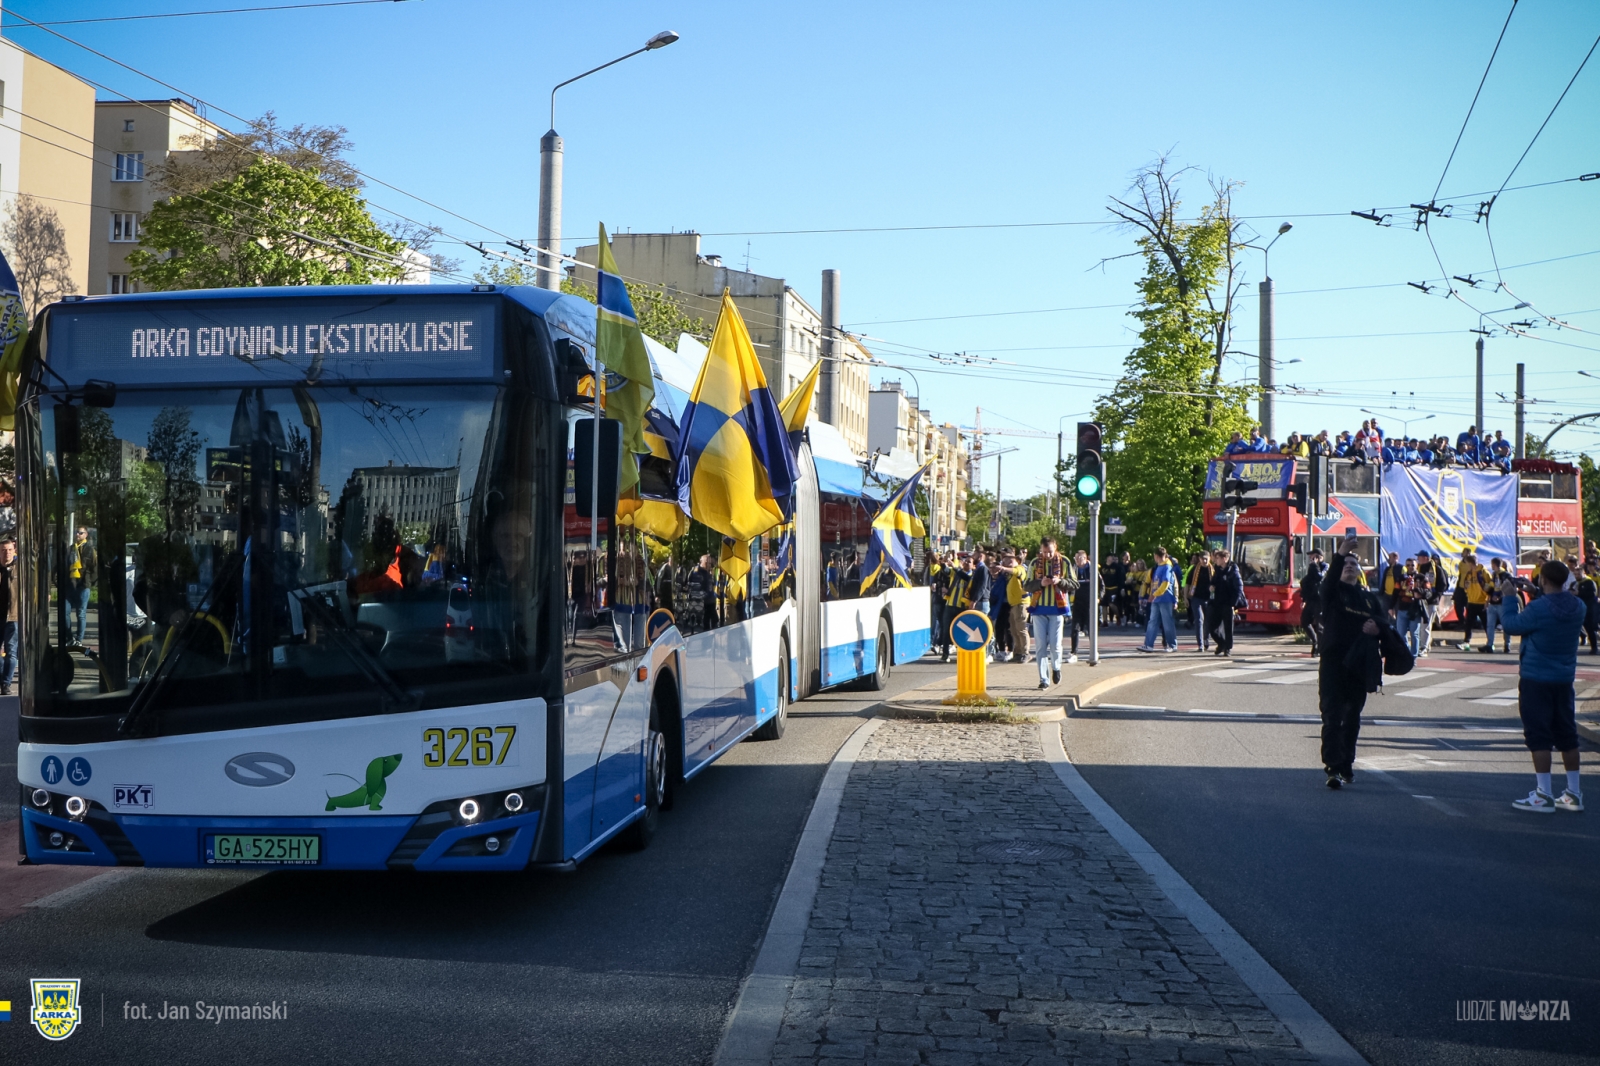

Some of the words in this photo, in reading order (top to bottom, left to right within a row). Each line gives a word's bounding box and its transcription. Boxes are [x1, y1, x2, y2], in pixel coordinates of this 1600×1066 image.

[132, 327, 190, 358] ARKA
[196, 325, 275, 358] GDYNIA
[281, 325, 298, 355] W
[304, 320, 474, 355] EKSTRAKLASIE
[1240, 463, 1283, 478] AHOJ
[423, 725, 517, 768] 3267
[114, 789, 152, 807] PKT
[219, 838, 243, 858] GA
[252, 838, 314, 858] 525HY
